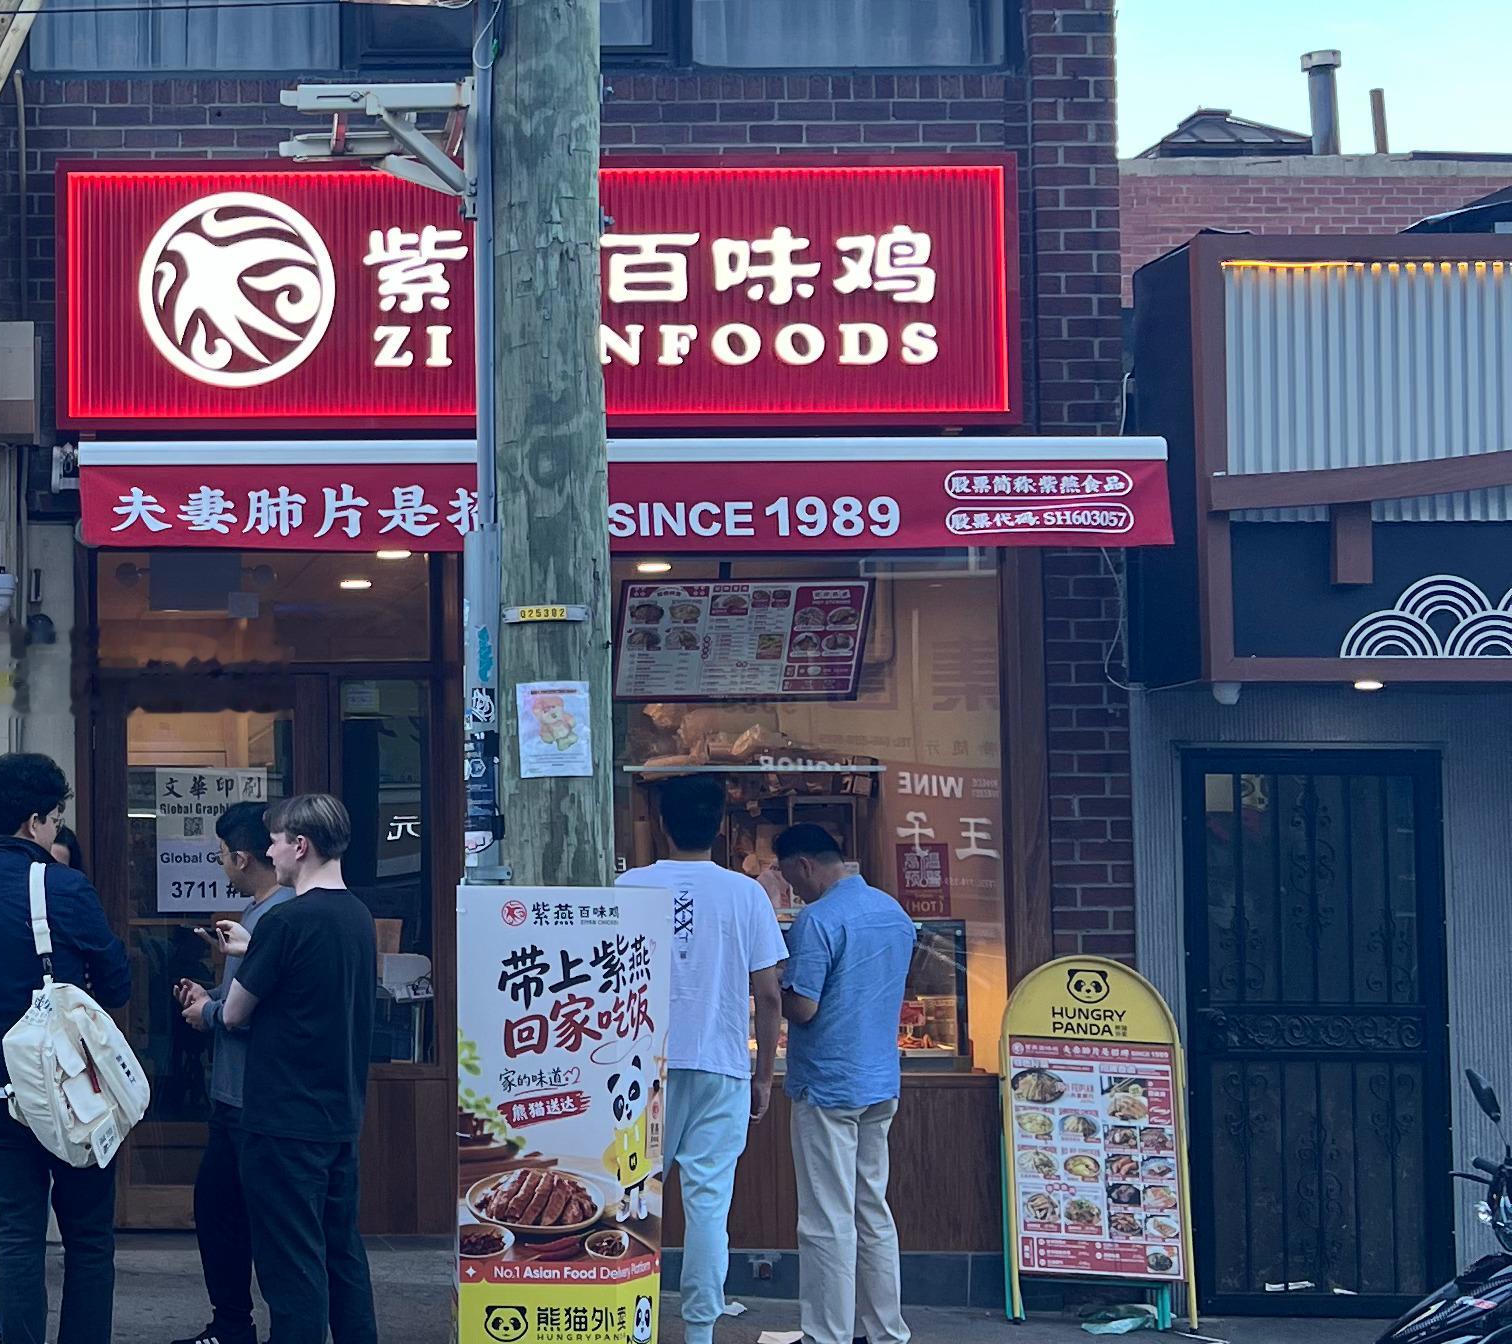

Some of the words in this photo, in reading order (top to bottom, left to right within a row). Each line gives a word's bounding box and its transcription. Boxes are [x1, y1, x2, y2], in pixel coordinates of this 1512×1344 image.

[607, 501, 756, 538] SINCE
[764, 495, 901, 539] 1989
[162, 775, 262, 800] 文華印刷
[159, 803, 193, 815] Global
[160, 852, 202, 864] Global
[171, 881, 218, 898] 3711
[1051, 1006, 1127, 1022] HUNGRY
[1052, 1022, 1114, 1037] PANDA
[494, 1266, 520, 1279] No.1
[523, 1266, 560, 1279] Asian
[563, 1266, 596, 1279] Food
